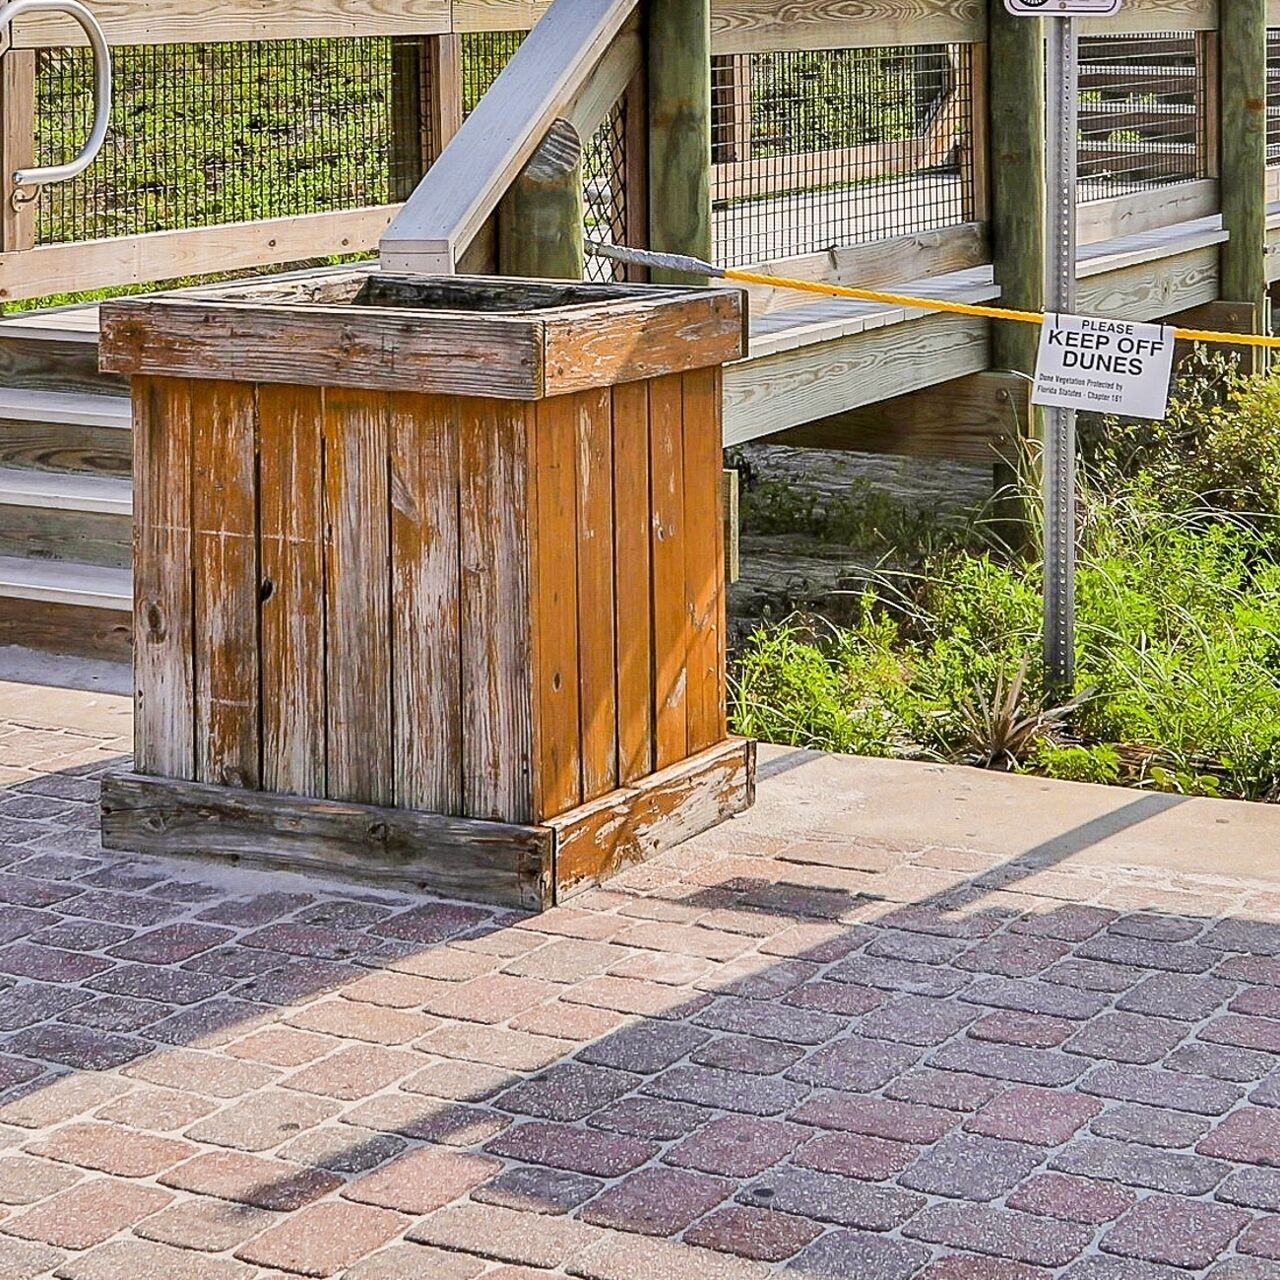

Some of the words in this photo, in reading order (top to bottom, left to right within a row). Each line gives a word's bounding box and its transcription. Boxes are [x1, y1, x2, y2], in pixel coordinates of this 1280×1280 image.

[1082, 320, 1134, 335] PLEASE
[1049, 330, 1109, 350] KEEP
[1118, 338, 1164, 356] OFF
[1063, 351, 1142, 375] DUNES
[1039, 373, 1053, 382] Dune
[1055, 376, 1085, 386] Vegetation
[1087, 379, 1114, 390] Protected
[1038, 386, 1057, 395] Florida
[1059, 388, 1082, 398] Statutes
[1088, 391, 1110, 402] Chapter
